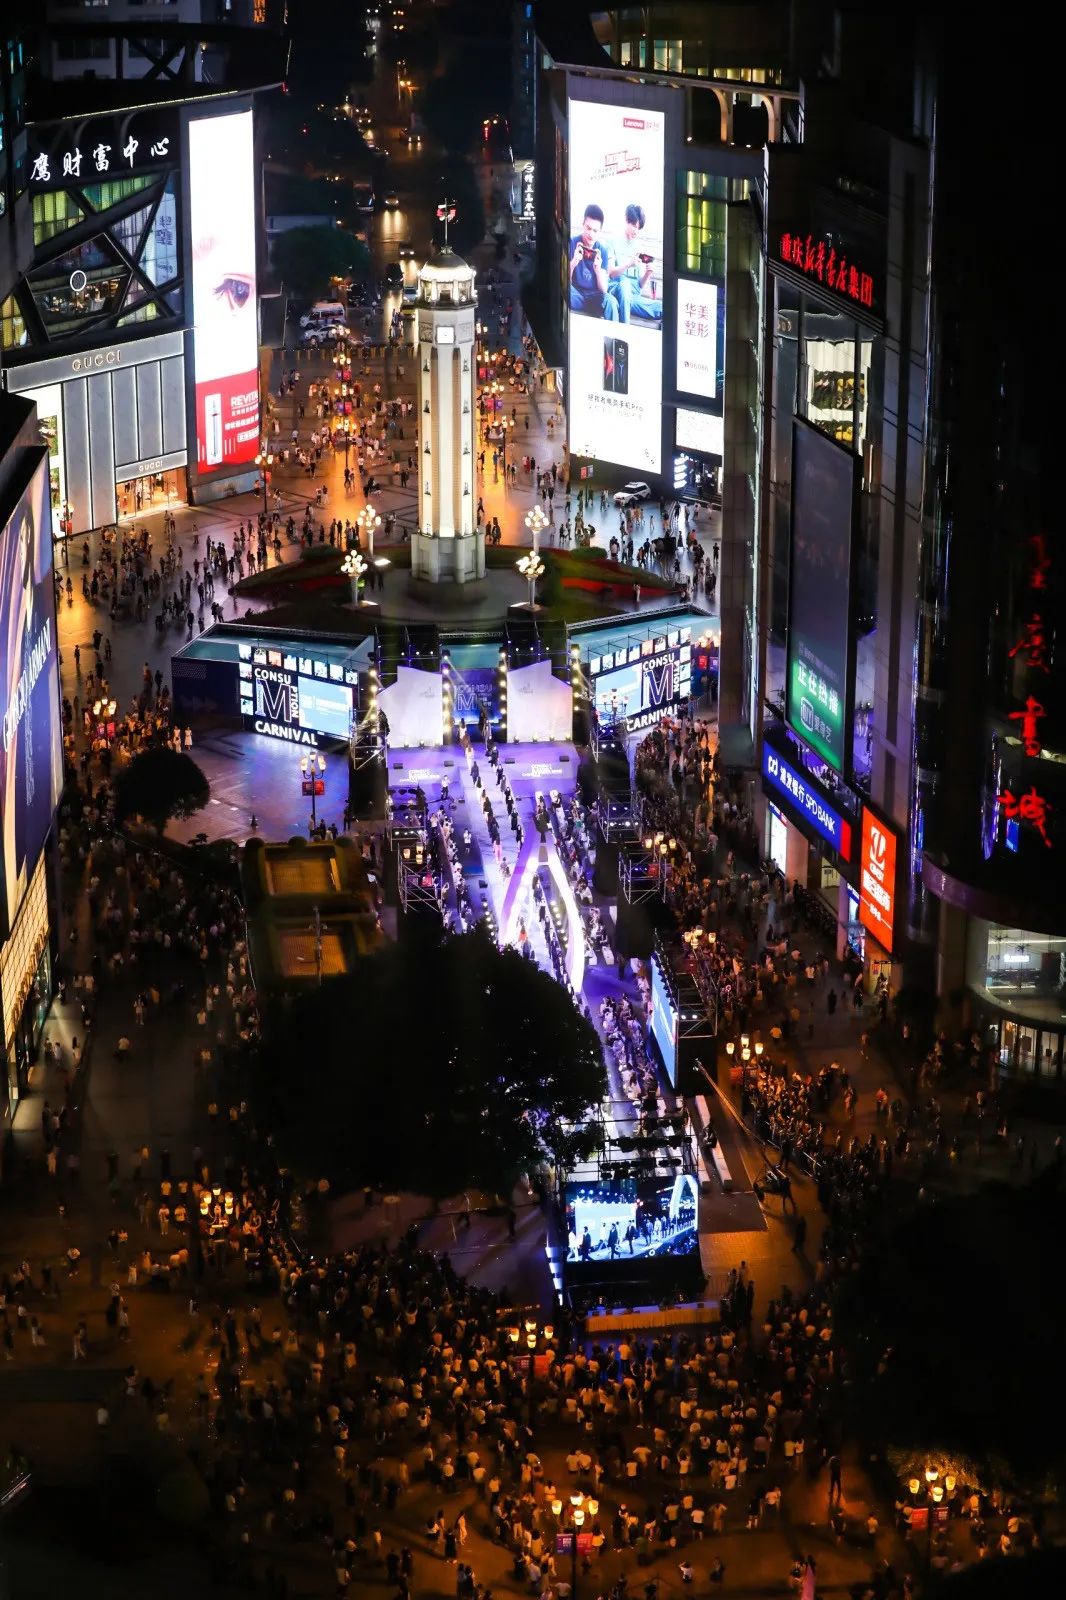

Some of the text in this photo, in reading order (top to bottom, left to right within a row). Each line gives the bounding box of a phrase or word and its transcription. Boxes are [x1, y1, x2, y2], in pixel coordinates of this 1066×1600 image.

[30, 135, 170, 181] 鹰财富中心
[684, 302, 709, 320] 华美
[684, 319, 709, 338] 整形
[72, 350, 121, 371] GUCCI
[138, 461, 163, 472] GUCCI
[29, 617, 51, 695] ARMANI
[642, 652, 675, 671] CONSU
[254, 668, 292, 685] CONSU
[798, 659, 839, 717] 正在热播
[254, 720, 319, 746] CARNIVAL
[780, 765, 836, 836] 浦发银行 SPD BANK
